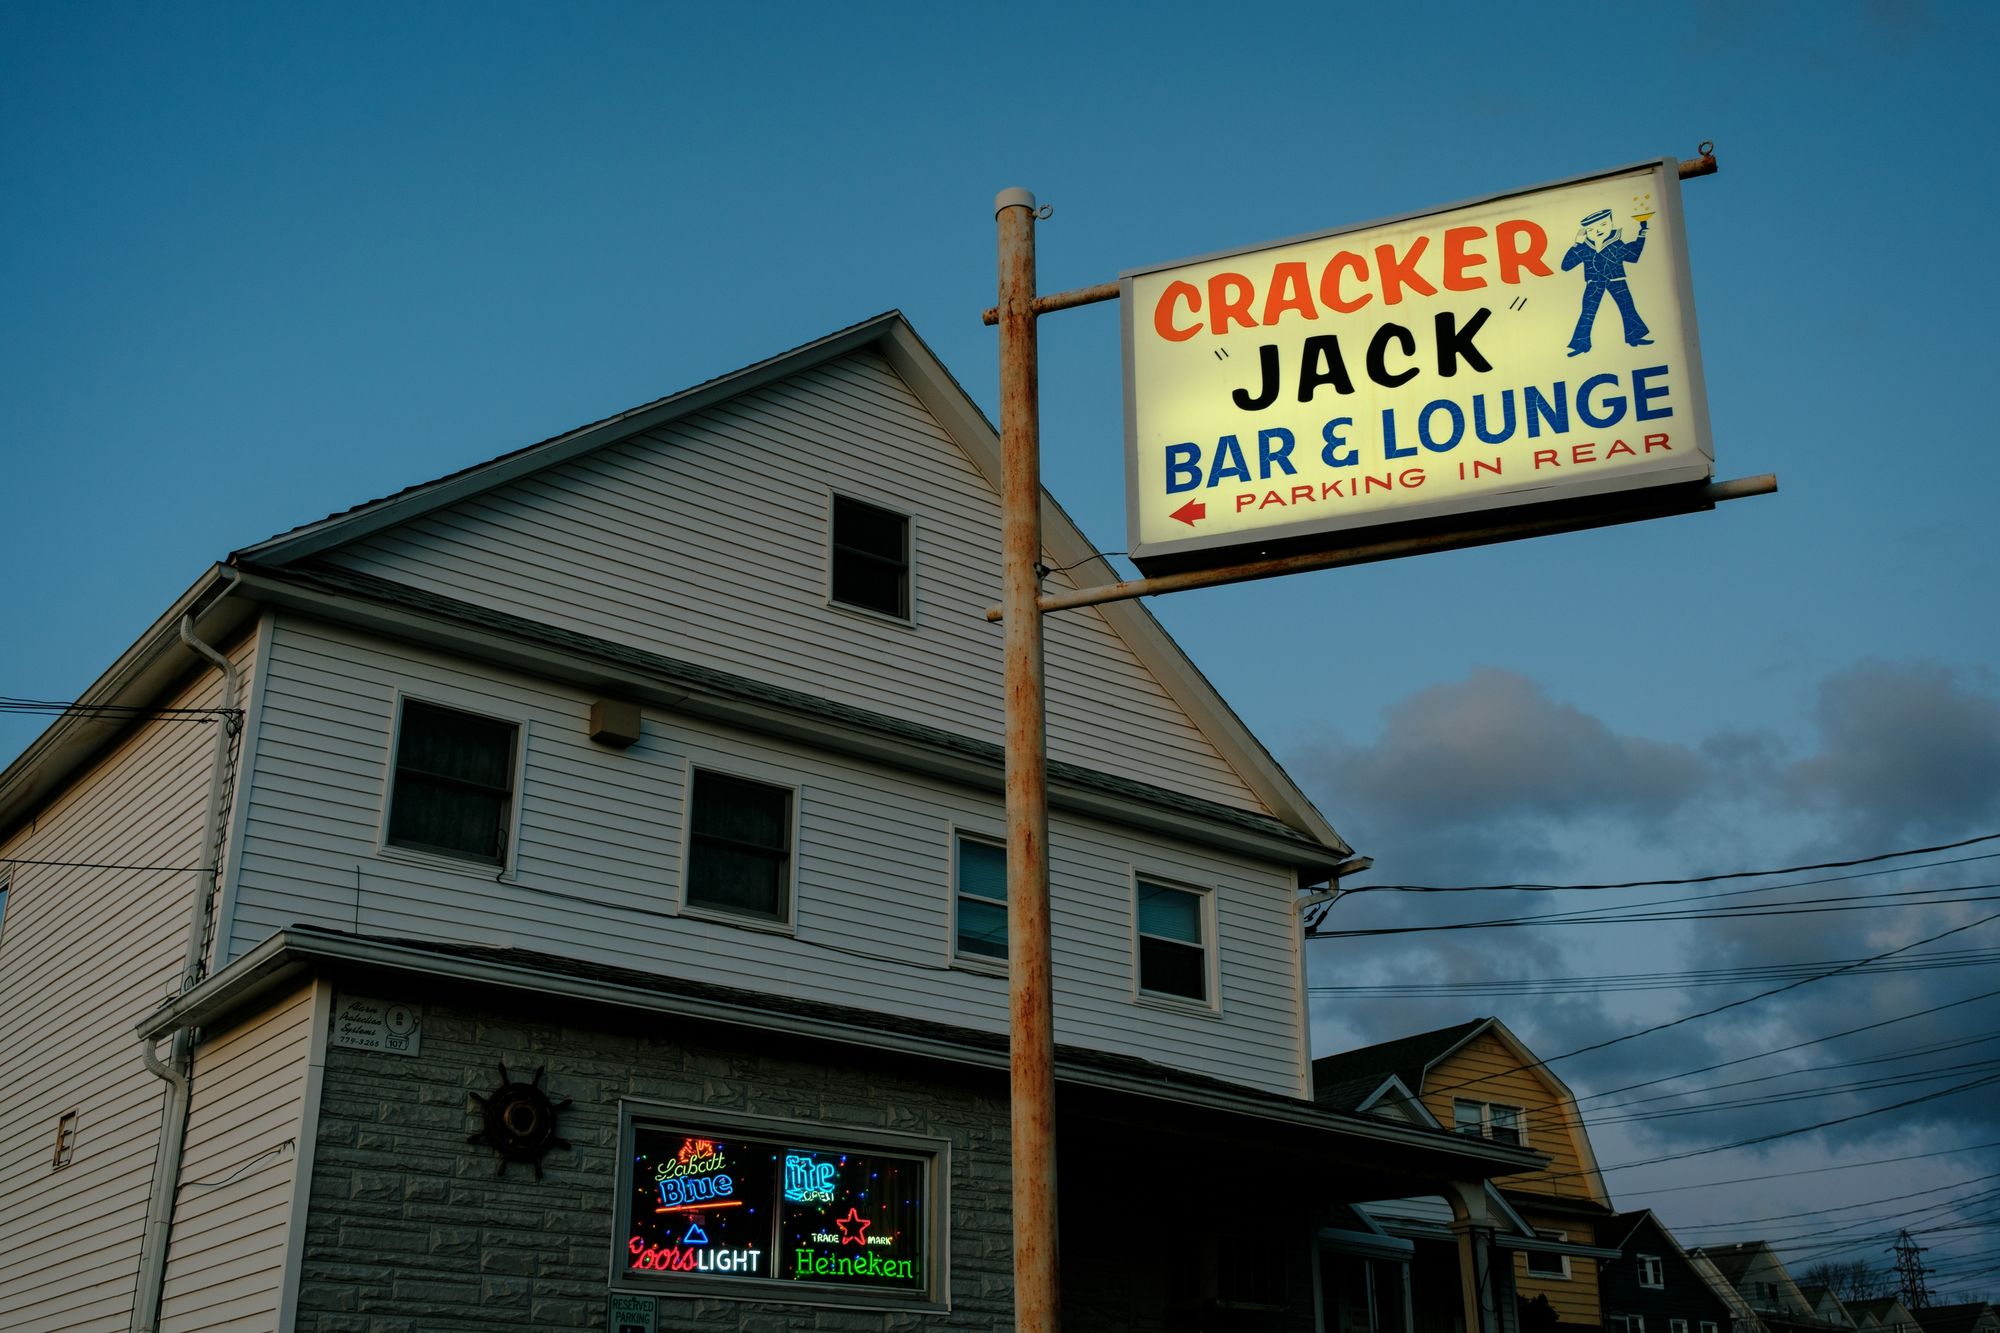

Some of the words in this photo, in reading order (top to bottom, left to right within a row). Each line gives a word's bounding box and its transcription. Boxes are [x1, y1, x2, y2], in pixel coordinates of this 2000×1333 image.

[1153, 219, 1554, 342] CRACKER
[1164, 426, 1298, 495] BAR
[1321, 417, 1359, 467] &
[1382, 365, 1674, 460] LOUNGE
[1236, 468, 1426, 513] PARKING
[1458, 457, 1502, 481] IN
[1533, 432, 1673, 470] REAR
[655, 1151, 727, 1181] Labatt
[659, 1173, 733, 1207] Blue
[803, 1190, 835, 1202] OPEN
[811, 1233, 839, 1244] TRADE
[867, 1236, 892, 1245] MARK
[628, 1236, 698, 1271] Coors
[698, 1249, 761, 1272] LIGHT
[795, 1249, 913, 1279] Heineken
[613, 1299, 654, 1312] RESERVED
[615, 1312, 651, 1324] PARKING
